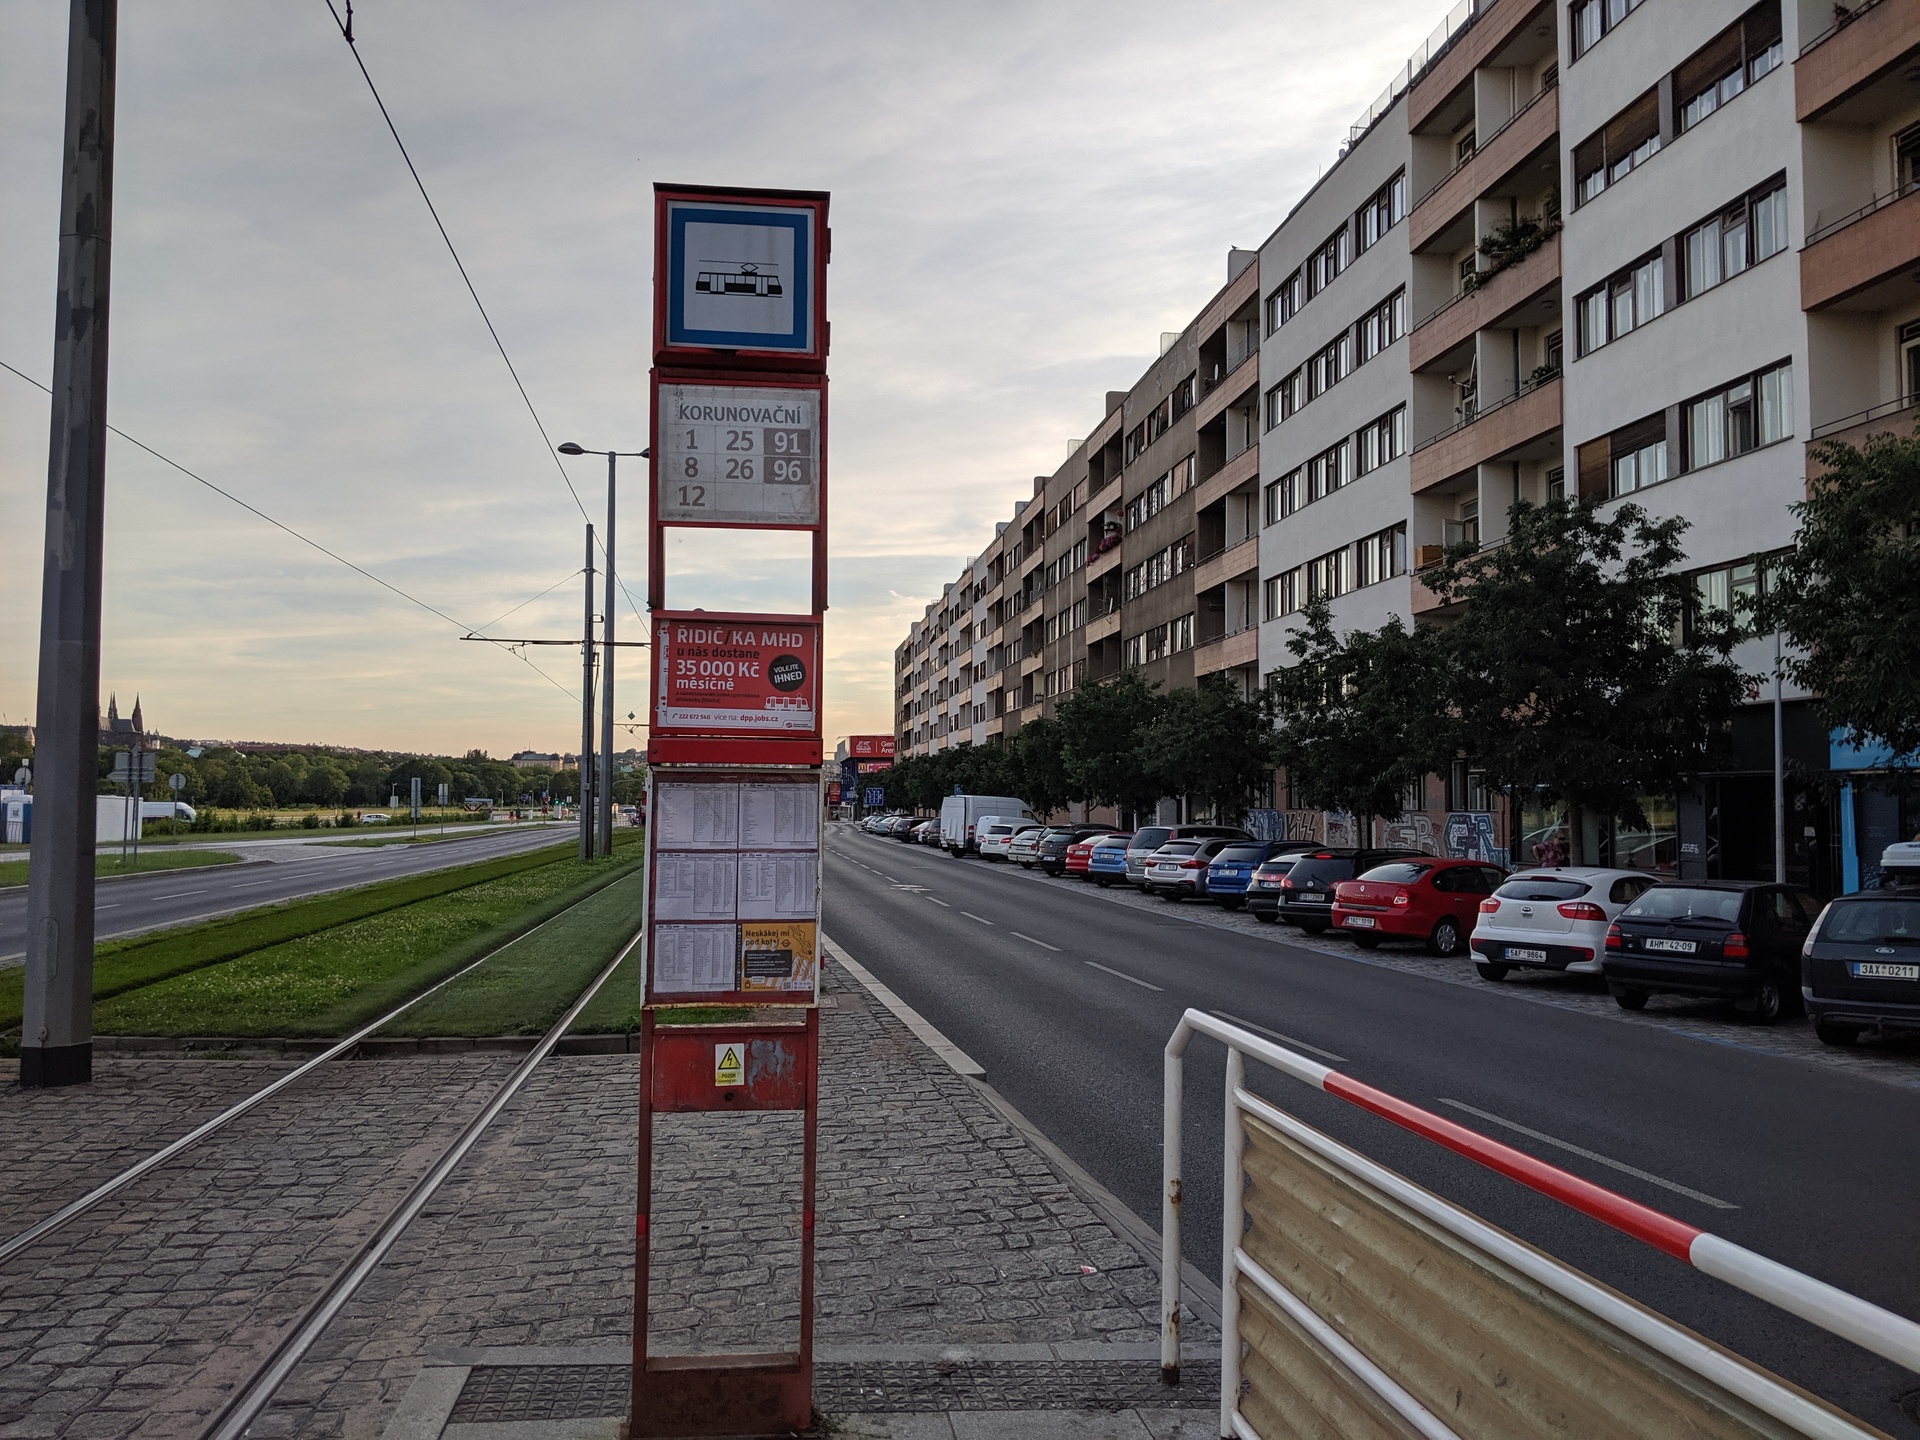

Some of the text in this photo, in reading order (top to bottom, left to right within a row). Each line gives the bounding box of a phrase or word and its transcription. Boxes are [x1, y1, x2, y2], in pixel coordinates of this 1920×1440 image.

[679, 405, 801, 424] KORUNOVAČNÍ
[686, 429, 801, 454] 1 25 91
[684, 457, 802, 482] 8 26 96
[678, 486, 706, 507] 12
[677, 624, 803, 648] ŘIDIČ/KA MHD
[677, 646, 760, 659] u nás dostane
[676, 660, 760, 678] 35 000 Kč
[773, 664, 799, 673] VOLEJTE
[676, 677, 734, 690] měsíčně
[774, 672, 803, 684] IHNED
[714, 713, 727, 721] více
[740, 714, 779, 723] dpp.jobs.cz
[745, 930, 779, 938] Neskákej
[1649, 940, 1693, 951] AHM 42-09
[1510, 949, 1544, 959] 5AF 9864
[1862, 964, 1914, 977] 3AX 0211
